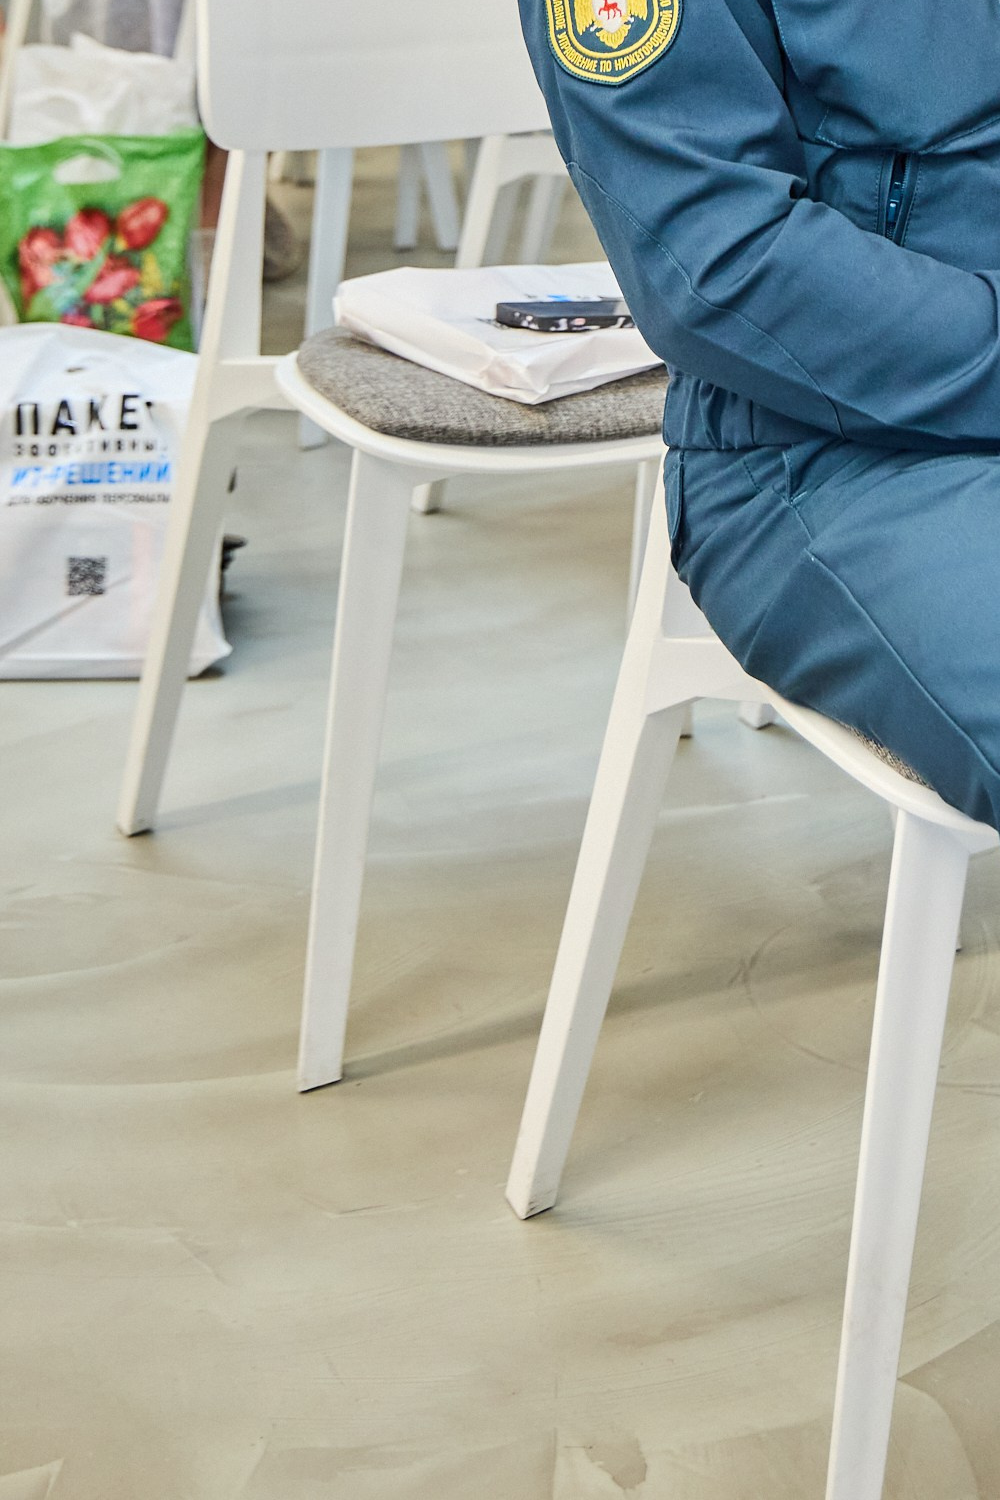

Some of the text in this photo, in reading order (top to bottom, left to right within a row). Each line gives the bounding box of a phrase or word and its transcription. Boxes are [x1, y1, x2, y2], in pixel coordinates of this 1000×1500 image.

[557, 31, 598, 73] УПРАВЛЕНИЕ
[600, 60, 612, 73] ПО
[614, 9, 673, 71] НИЖЕГОРОДСКОЙ
[15, 393, 155, 437] ПАКЕ
